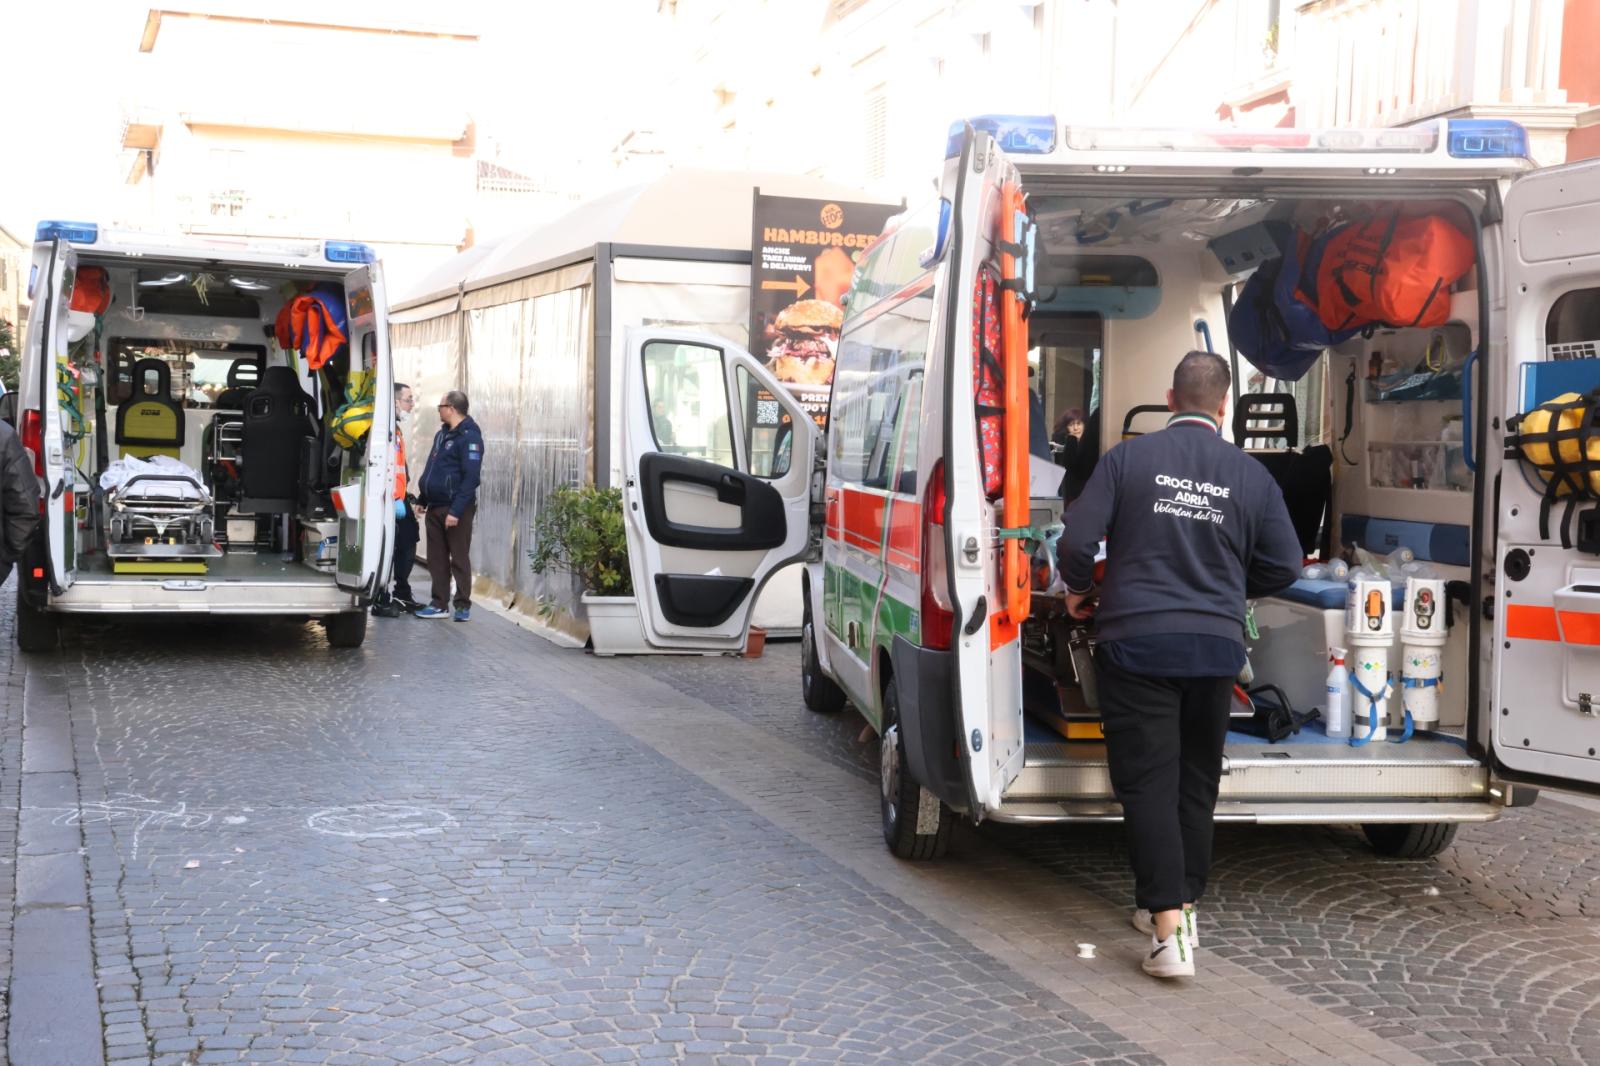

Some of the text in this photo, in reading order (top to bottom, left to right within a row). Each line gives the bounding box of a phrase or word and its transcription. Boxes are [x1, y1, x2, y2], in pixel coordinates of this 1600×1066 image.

[762, 247, 790, 255] ANCHE
[762, 255, 807, 264] TAKE AWAY
[770, 263, 812, 272] DELIVERY!
[1155, 475, 1193, 491] CROCE
[1175, 491, 1209, 506] ADRIA
[1193, 511, 1211, 520] dal
